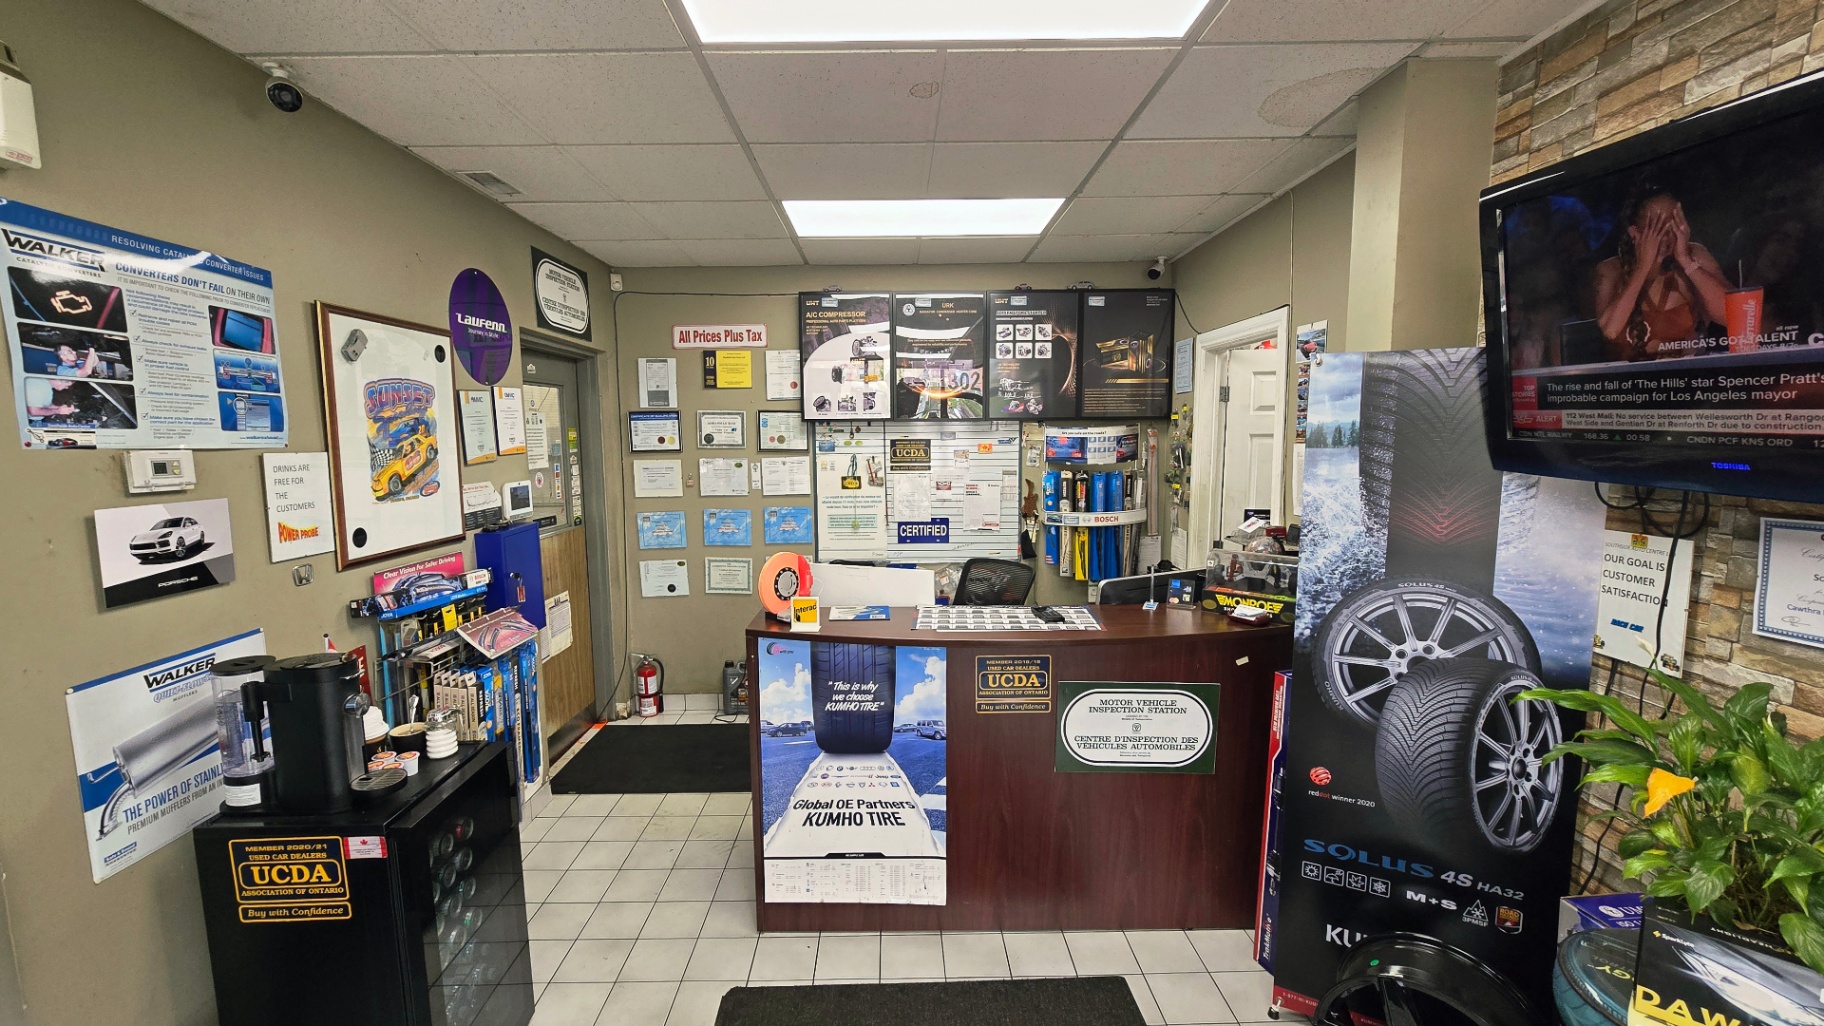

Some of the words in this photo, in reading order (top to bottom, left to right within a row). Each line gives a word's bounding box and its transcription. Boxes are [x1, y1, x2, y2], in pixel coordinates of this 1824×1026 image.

[1, 228, 106, 272] WALKER
[111, 234, 161, 254] RESOLVING
[243, 270, 264, 281] ISSUES
[115, 262, 179, 283] CONVERTERS
[181, 276, 207, 290] DON'T
[208, 281, 224, 294] FAIL
[226, 286, 236, 296] ON
[237, 288, 256, 301] THEIR
[256, 292, 271, 305] OWN
[467, 327, 484, 336] Journey
[678, 330, 691, 344] All
[693, 330, 722, 343] Prices
[724, 329, 744, 343] Plus
[746, 329, 763, 342] Tax
[1658, 336, 1716, 351] AMERICA'S
[1719, 335, 1745, 346] GOT
[705, 356, 715, 367] 10
[1547, 383, 1564, 392] The
[1565, 382, 1582, 391] rise
[1584, 381, 1602, 391] and
[1604, 380, 1619, 390] fall
[1621, 379, 1633, 389] of
[1634, 379, 1658, 389] 'The
[1661, 377, 1688, 388] Hills'
[1691, 377, 1715, 388] star
[1717, 375, 1776, 389] Spencer
[364, 380, 435, 416] SUNSET
[1547, 393, 1598, 405] improbable
[1600, 393, 1651, 404] campaign
[1652, 391, 1667, 401] for
[1670, 391, 1691, 401] Los
[1694, 390, 1747, 403] Angeles
[1751, 389, 1798, 402] mayor
[1535, 415, 1557, 423] ALERT
[1657, 413, 1693, 421] between
[1695, 413, 1753, 421] Wellesworth
[1756, 413, 1768, 421] Dr
[1615, 420, 1645, 428] Gentian
[1668, 421, 1705, 429] Renforth
[896, 448, 926, 457] UCDA
[273, 465, 297, 473] DRINKS
[298, 464, 310, 472] ARE
[1711, 461, 1751, 471] TOSHIBA
[274, 478, 290, 486] FREE
[291, 477, 305, 485] FOR
[275, 492, 288, 500] THE
[276, 501, 316, 513] CUSTOMERS
[277, 521, 300, 544] POWER
[300, 526, 319, 540] PROBE
[899, 524, 948, 537] CERTIFIED
[1646, 547, 1666, 557] CENTRE
[383, 570, 399, 580] Clear
[399, 566, 416, 575] Vision
[425, 560, 439, 569] Safer
[438, 555, 456, 565] Driving
[1604, 553, 1625, 565] OUR
[1626, 557, 1654, 570] GOAL
[1656, 561, 1666, 572] IS
[157, 575, 199, 588] PORSCHE
[1602, 569, 1656, 588] CUSTOMER
[1601, 584, 1668, 608] SATISFACTIO
[794, 603, 817, 617] Interac
[1219, 594, 1280, 613] MONROE
[1610, 618, 1629, 629] RACE
[1629, 623, 1645, 633] CAR
[143, 657, 216, 690] WALKER
[851, 681, 860, 691] is
[861, 682, 879, 693] why
[987, 673, 1041, 688] UCDA
[846, 692, 874, 701] choose
[1324, 680, 1345, 711] KUMHO
[825, 702, 859, 711] KUMHO
[1010, 703, 1046, 711] Confidence
[1136, 699, 1178, 707] VEHICLE
[1074, 735, 1112, 743] CENTRE
[1131, 743, 1196, 751] AUTOMOBILES
[122, 805, 143, 823] THE
[144, 787, 180, 815] POWER
[180, 778, 193, 795] OF
[793, 799, 834, 810] Global
[836, 799, 854, 810] OE
[857, 799, 916, 810] Partners
[1331, 794, 1356, 804] winner
[1356, 798, 1376, 808] 2020
[127, 811, 160, 835] PREMIUM
[161, 794, 191, 820] MUFFLERS
[191, 787, 208, 805] FROM
[802, 811, 864, 827] KUMHO
[866, 811, 906, 827] TIRE
[245, 844, 285, 852] MEMBER
[286, 843, 328, 851] 2020/21
[272, 853, 289, 861] CAR
[290, 852, 327, 860] DEALERS
[250, 863, 332, 885] UCDA
[1303, 839, 1434, 879] SOLUS
[1440, 870, 1475, 888] 4S
[1476, 881, 1525, 901] HA32
[241, 888, 294, 897] ASSOCIATION
[295, 887, 307, 895] OF
[308, 886, 344, 895] ONTARIO
[1406, 890, 1458, 911] M+S
[248, 909, 267, 919] Buy
[268, 908, 290, 917] with
[291, 907, 344, 917] Confidence
[1462, 916, 1489, 927] 3PMSF
